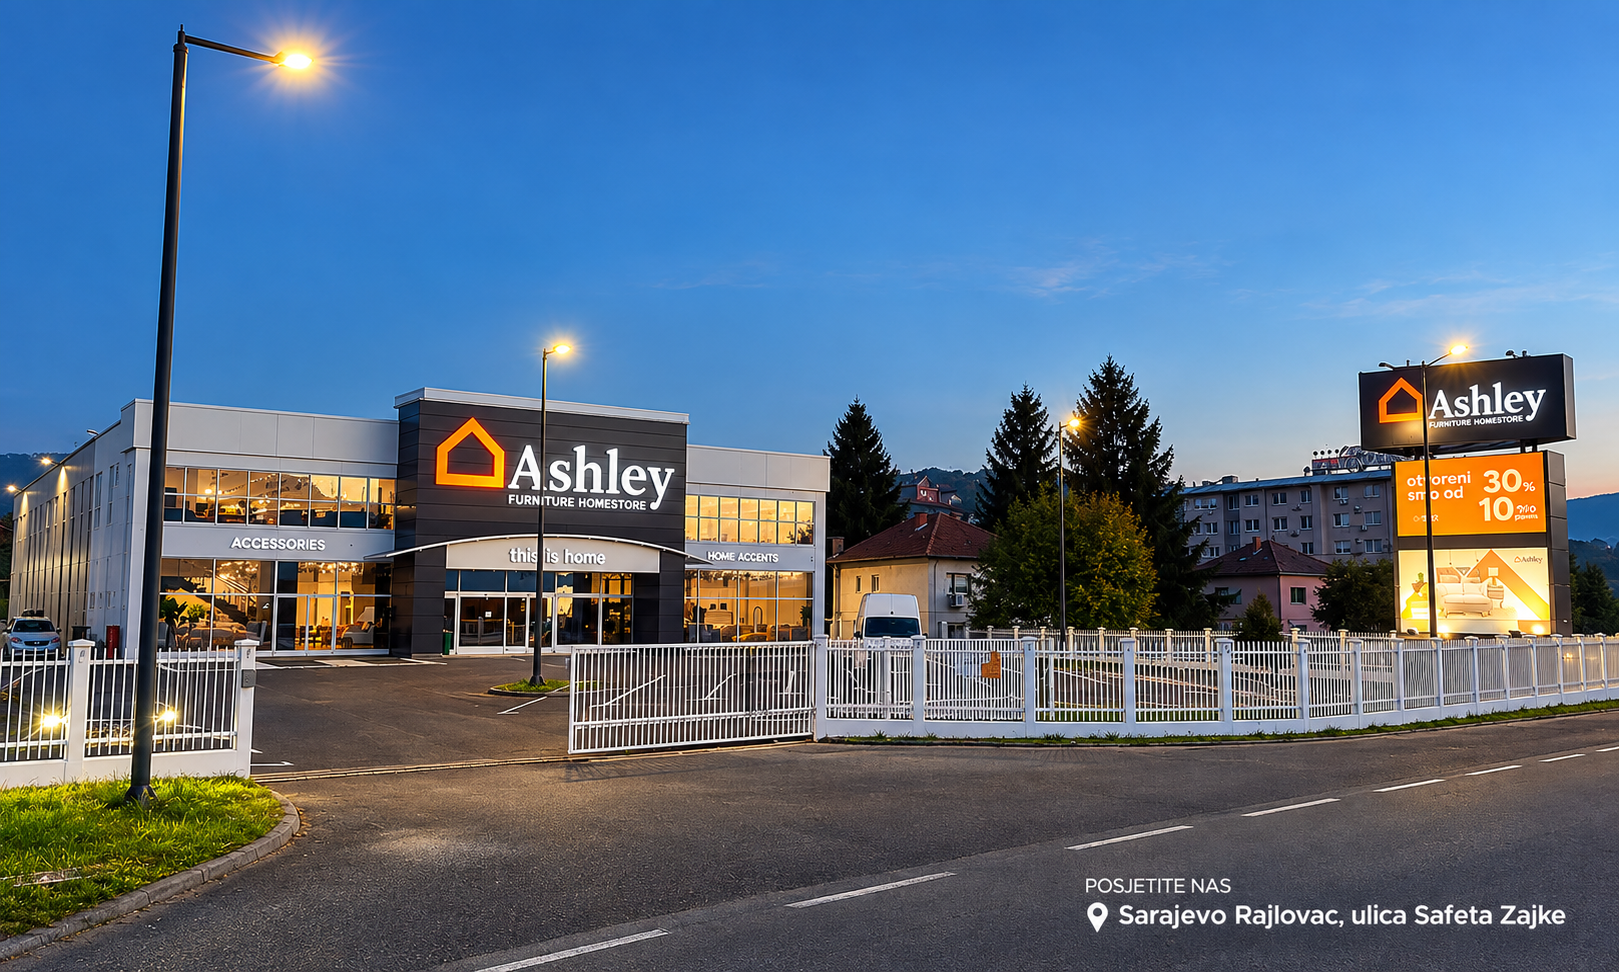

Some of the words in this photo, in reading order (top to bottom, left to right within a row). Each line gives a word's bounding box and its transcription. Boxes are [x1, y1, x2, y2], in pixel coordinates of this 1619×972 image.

[1428, 381, 1547, 422] Ashley
[1429, 418, 1472, 429] FURNITURE
[1474, 414, 1524, 426] HOMESTORE
[507, 444, 675, 511] Ashley
[1443, 485, 1464, 499] od
[508, 494, 575, 508] FURNITURE
[578, 497, 647, 511] HOMESTORE
[1478, 496, 1514, 522] 10
[231, 536, 326, 552] ACCESSORIES
[509, 547, 538, 563] this
[545, 547, 559, 564] is
[564, 548, 607, 565] home
[707, 551, 736, 562] HOME
[737, 552, 780, 563] ACCENTS
